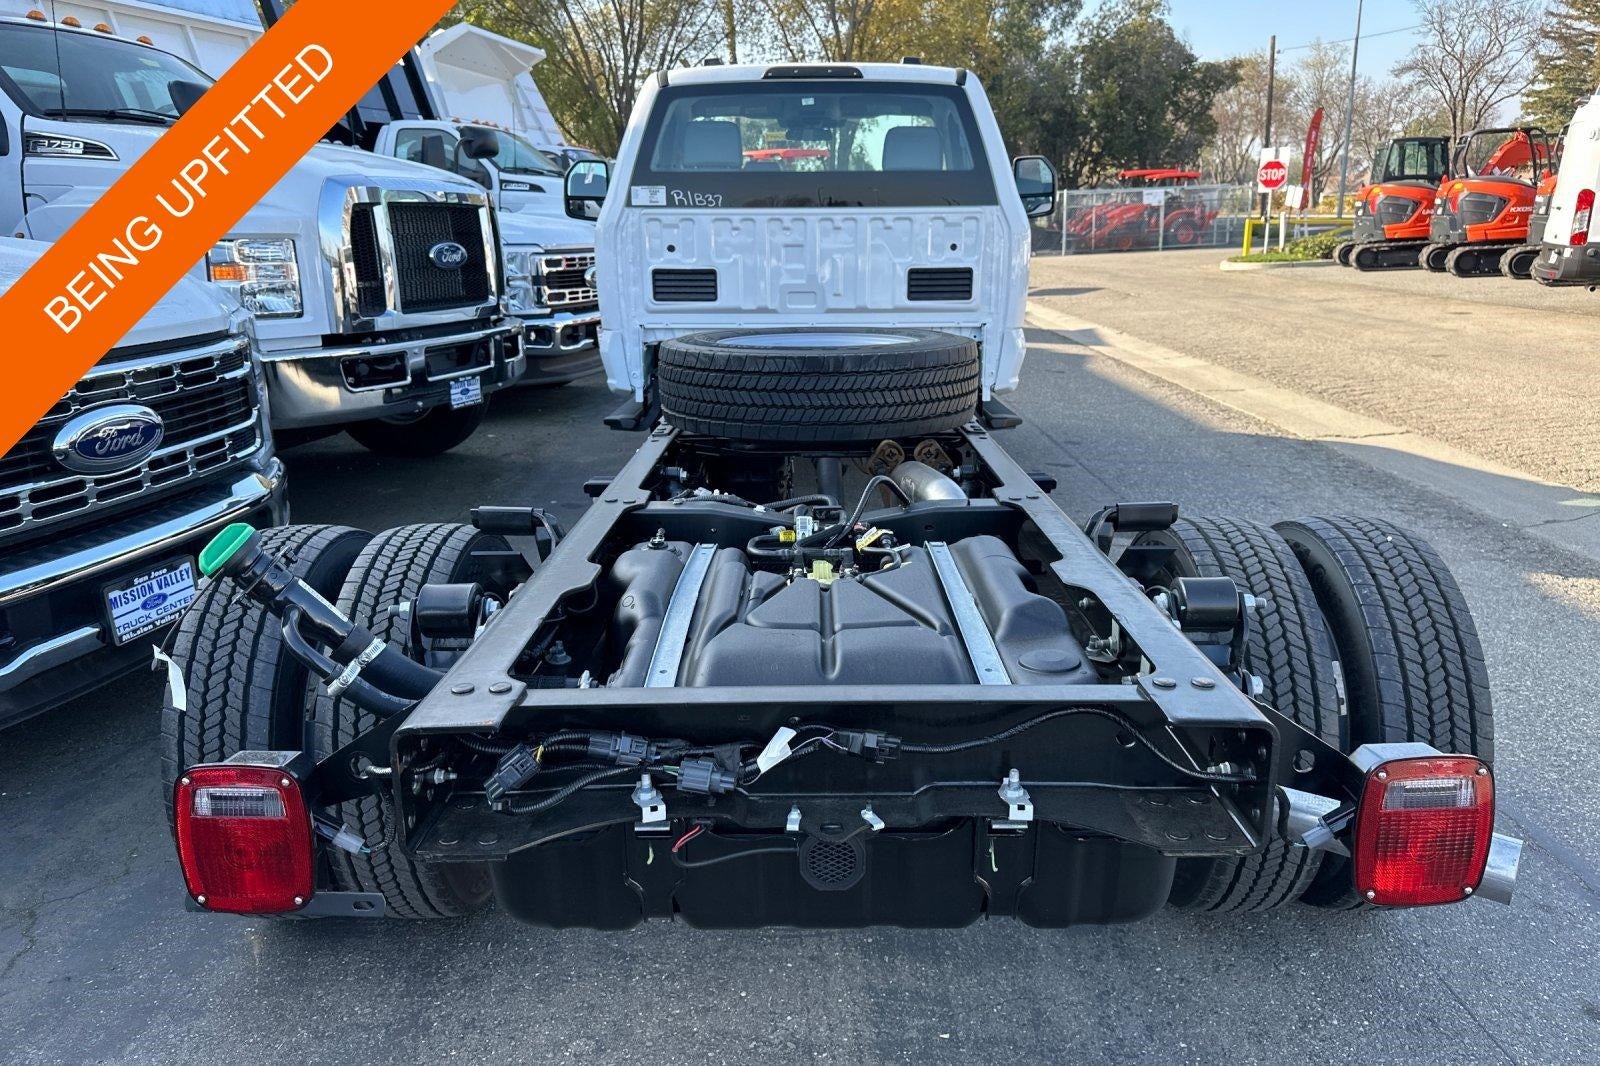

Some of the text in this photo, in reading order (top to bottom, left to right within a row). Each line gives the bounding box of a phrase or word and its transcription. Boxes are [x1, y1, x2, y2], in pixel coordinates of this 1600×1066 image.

[1260, 168, 1285, 181] STOP
[442, 245, 462, 262] Ford
[94, 421, 145, 455] Ford
[133, 568, 168, 585] San Jose
[109, 566, 192, 611] MISSION VALLEY
[116, 612, 153, 634] TRUCK
[154, 611, 180, 627] Valley
